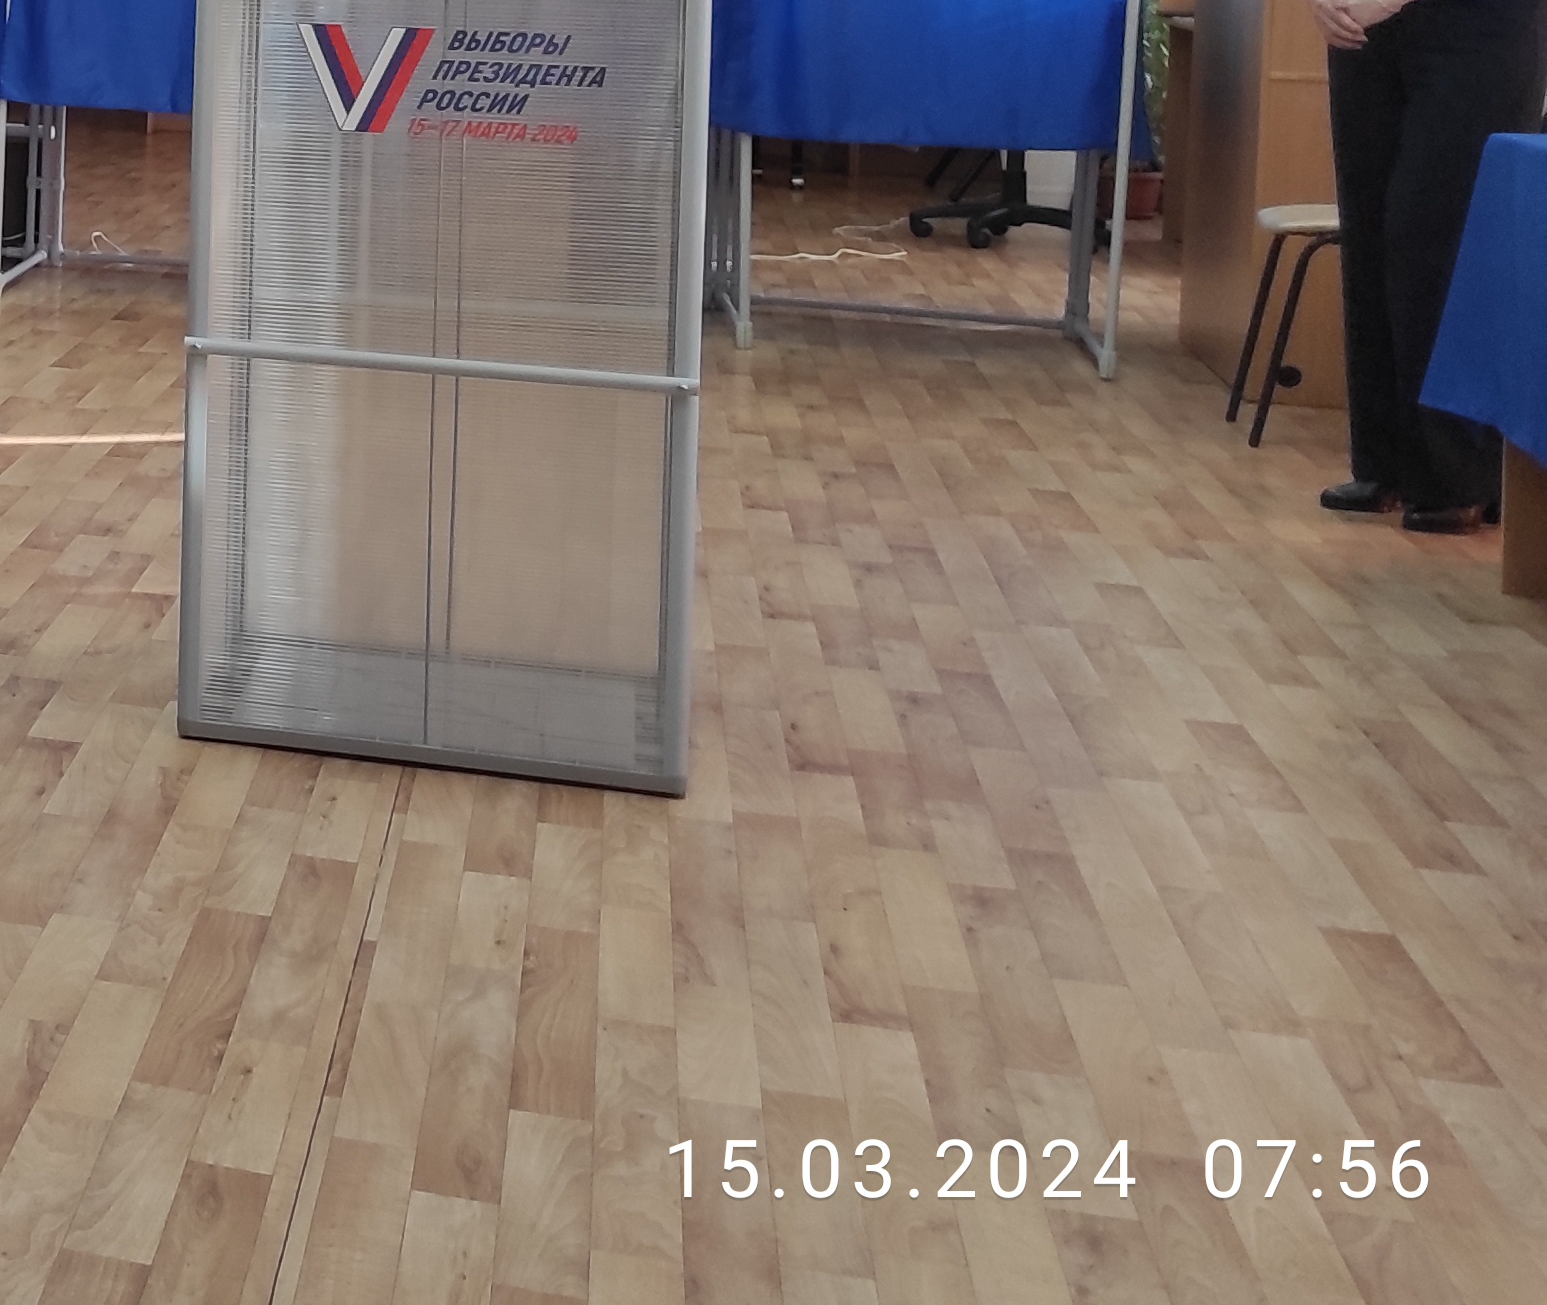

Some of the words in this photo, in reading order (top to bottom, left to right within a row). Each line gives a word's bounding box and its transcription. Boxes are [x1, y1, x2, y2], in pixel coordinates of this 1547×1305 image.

[447, 29, 572, 56] ВЫБОРЫ
[431, 59, 607, 89] ПРЕЗИДЕНТА
[416, 88, 530, 115] РОССИИ
[463, 120, 528, 141] МАРТА
[530, 123, 579, 144] 2024
